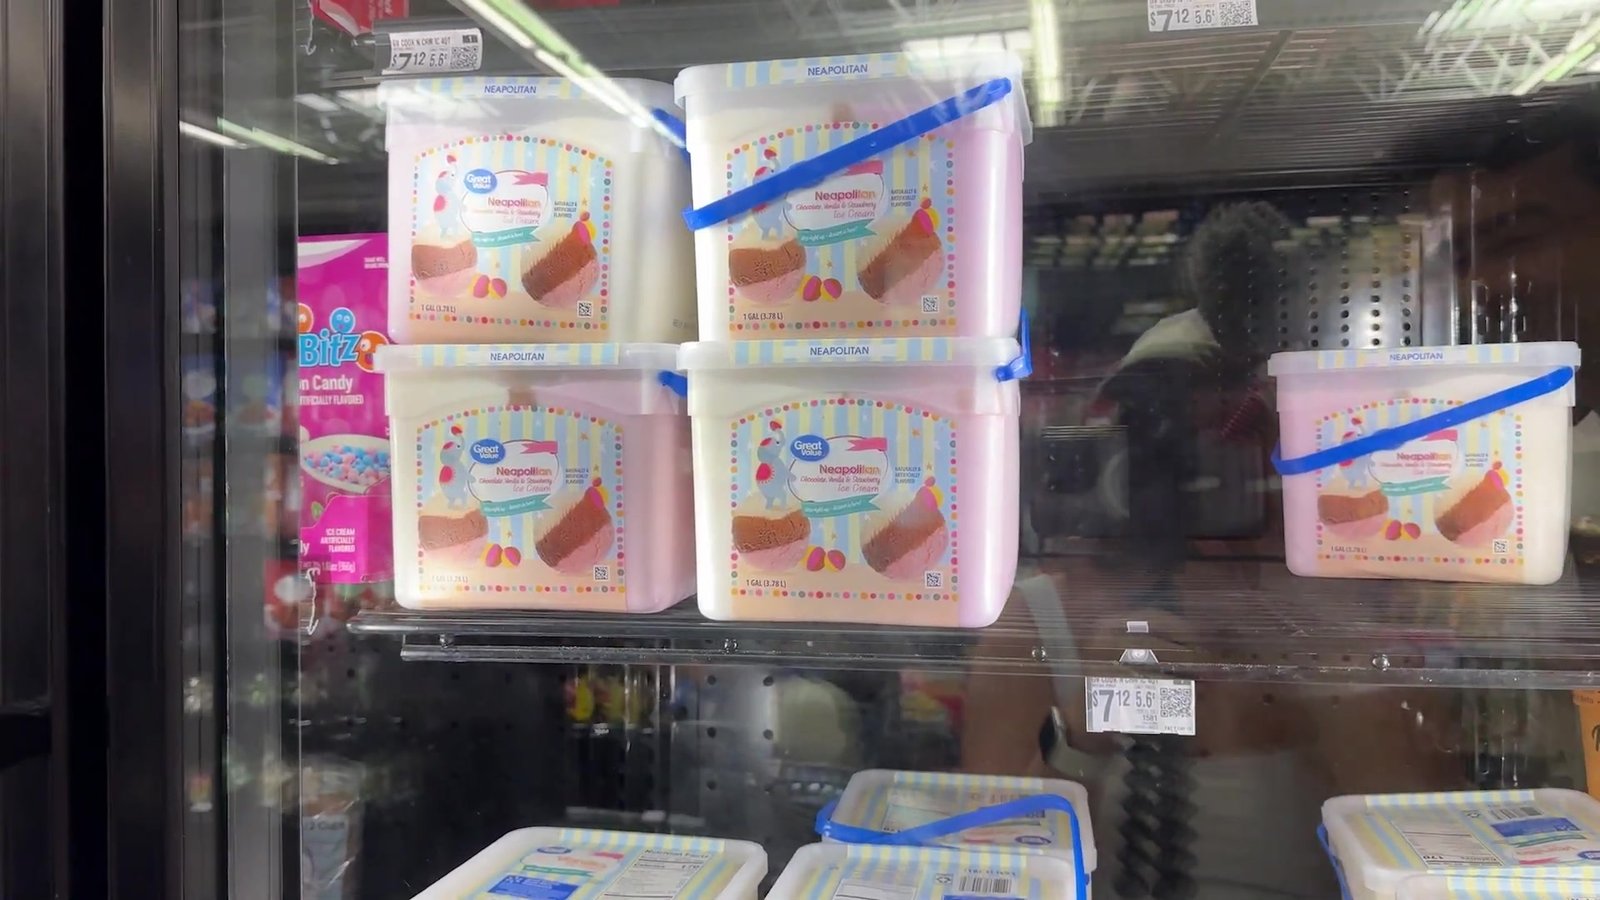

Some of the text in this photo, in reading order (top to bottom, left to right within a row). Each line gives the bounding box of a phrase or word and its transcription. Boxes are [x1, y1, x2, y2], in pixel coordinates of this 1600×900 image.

[807, 63, 868, 76] NEAPOLITAN
[484, 85, 537, 94] NEAPOLITAN
[466, 174, 492, 184] Great
[472, 182, 492, 190] Value
[815, 190, 876, 203] Neapolitan
[487, 197, 541, 207] Neapolitan
[848, 209, 876, 219] Cream
[808, 346, 870, 356] NEAPOLITAN
[490, 352, 545, 361] NEAPOLITAN
[1389, 352, 1444, 361] NEAPOLITAN
[312, 374, 353, 394] Candy
[473, 444, 499, 454] Great
[794, 440, 822, 451] Great
[800, 448, 822, 456] Value
[1396, 452, 1452, 463] Neapolitan
[496, 467, 552, 478] Neapolitan
[819, 464, 880, 476] Neapolitan
[852, 484, 879, 493] Cream
[763, 580, 780, 588] (3.78
